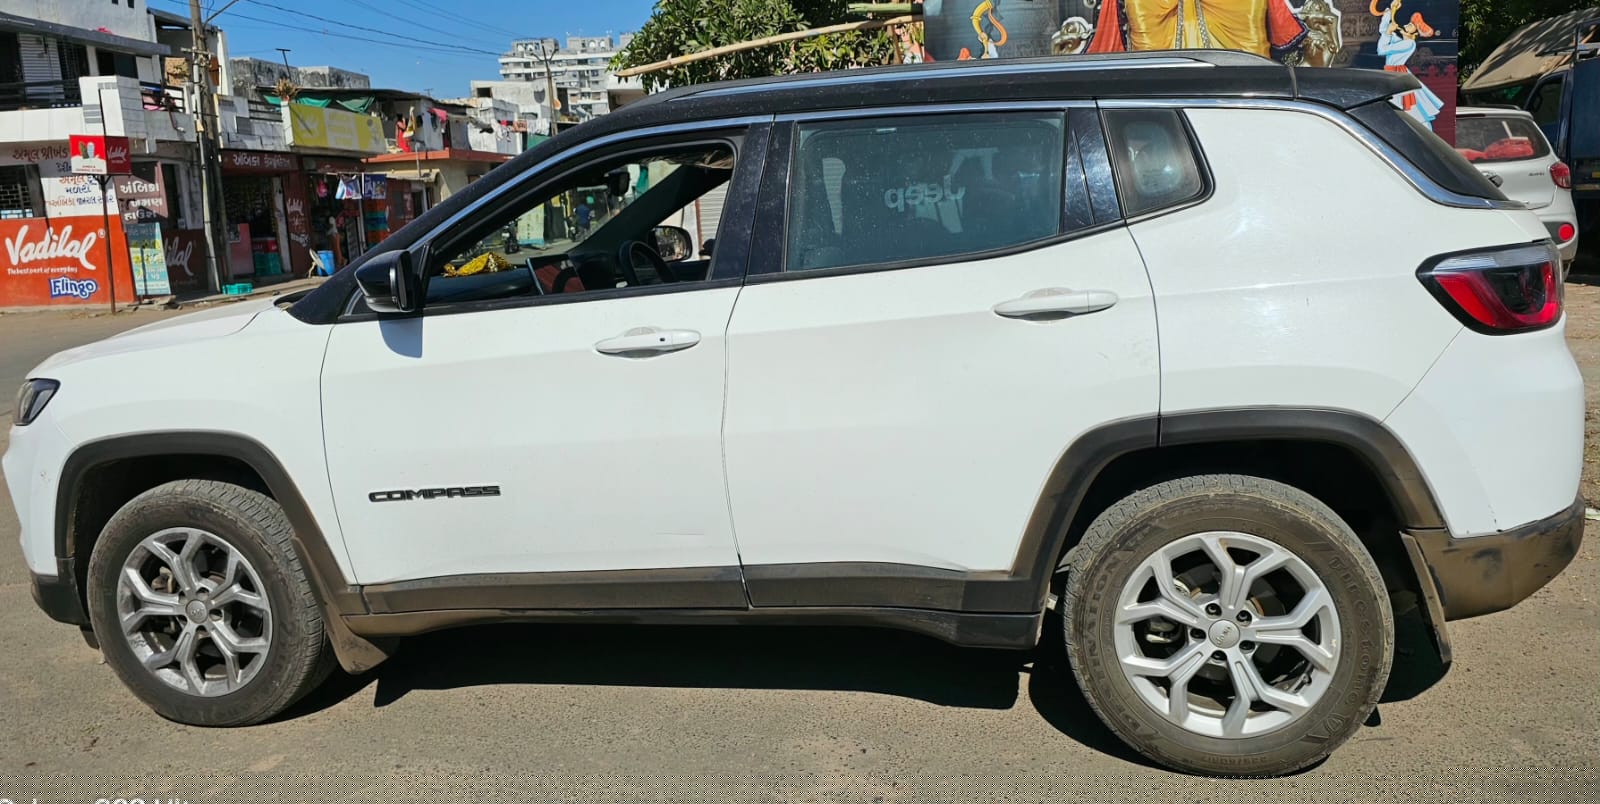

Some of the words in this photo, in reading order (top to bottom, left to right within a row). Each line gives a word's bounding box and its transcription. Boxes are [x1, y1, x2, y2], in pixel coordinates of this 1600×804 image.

[120, 181, 160, 194] અંબિકા
[5, 225, 96, 270] Vadilal
[50, 276, 98, 299] Flingo
[368, 485, 501, 502] COMPASS
